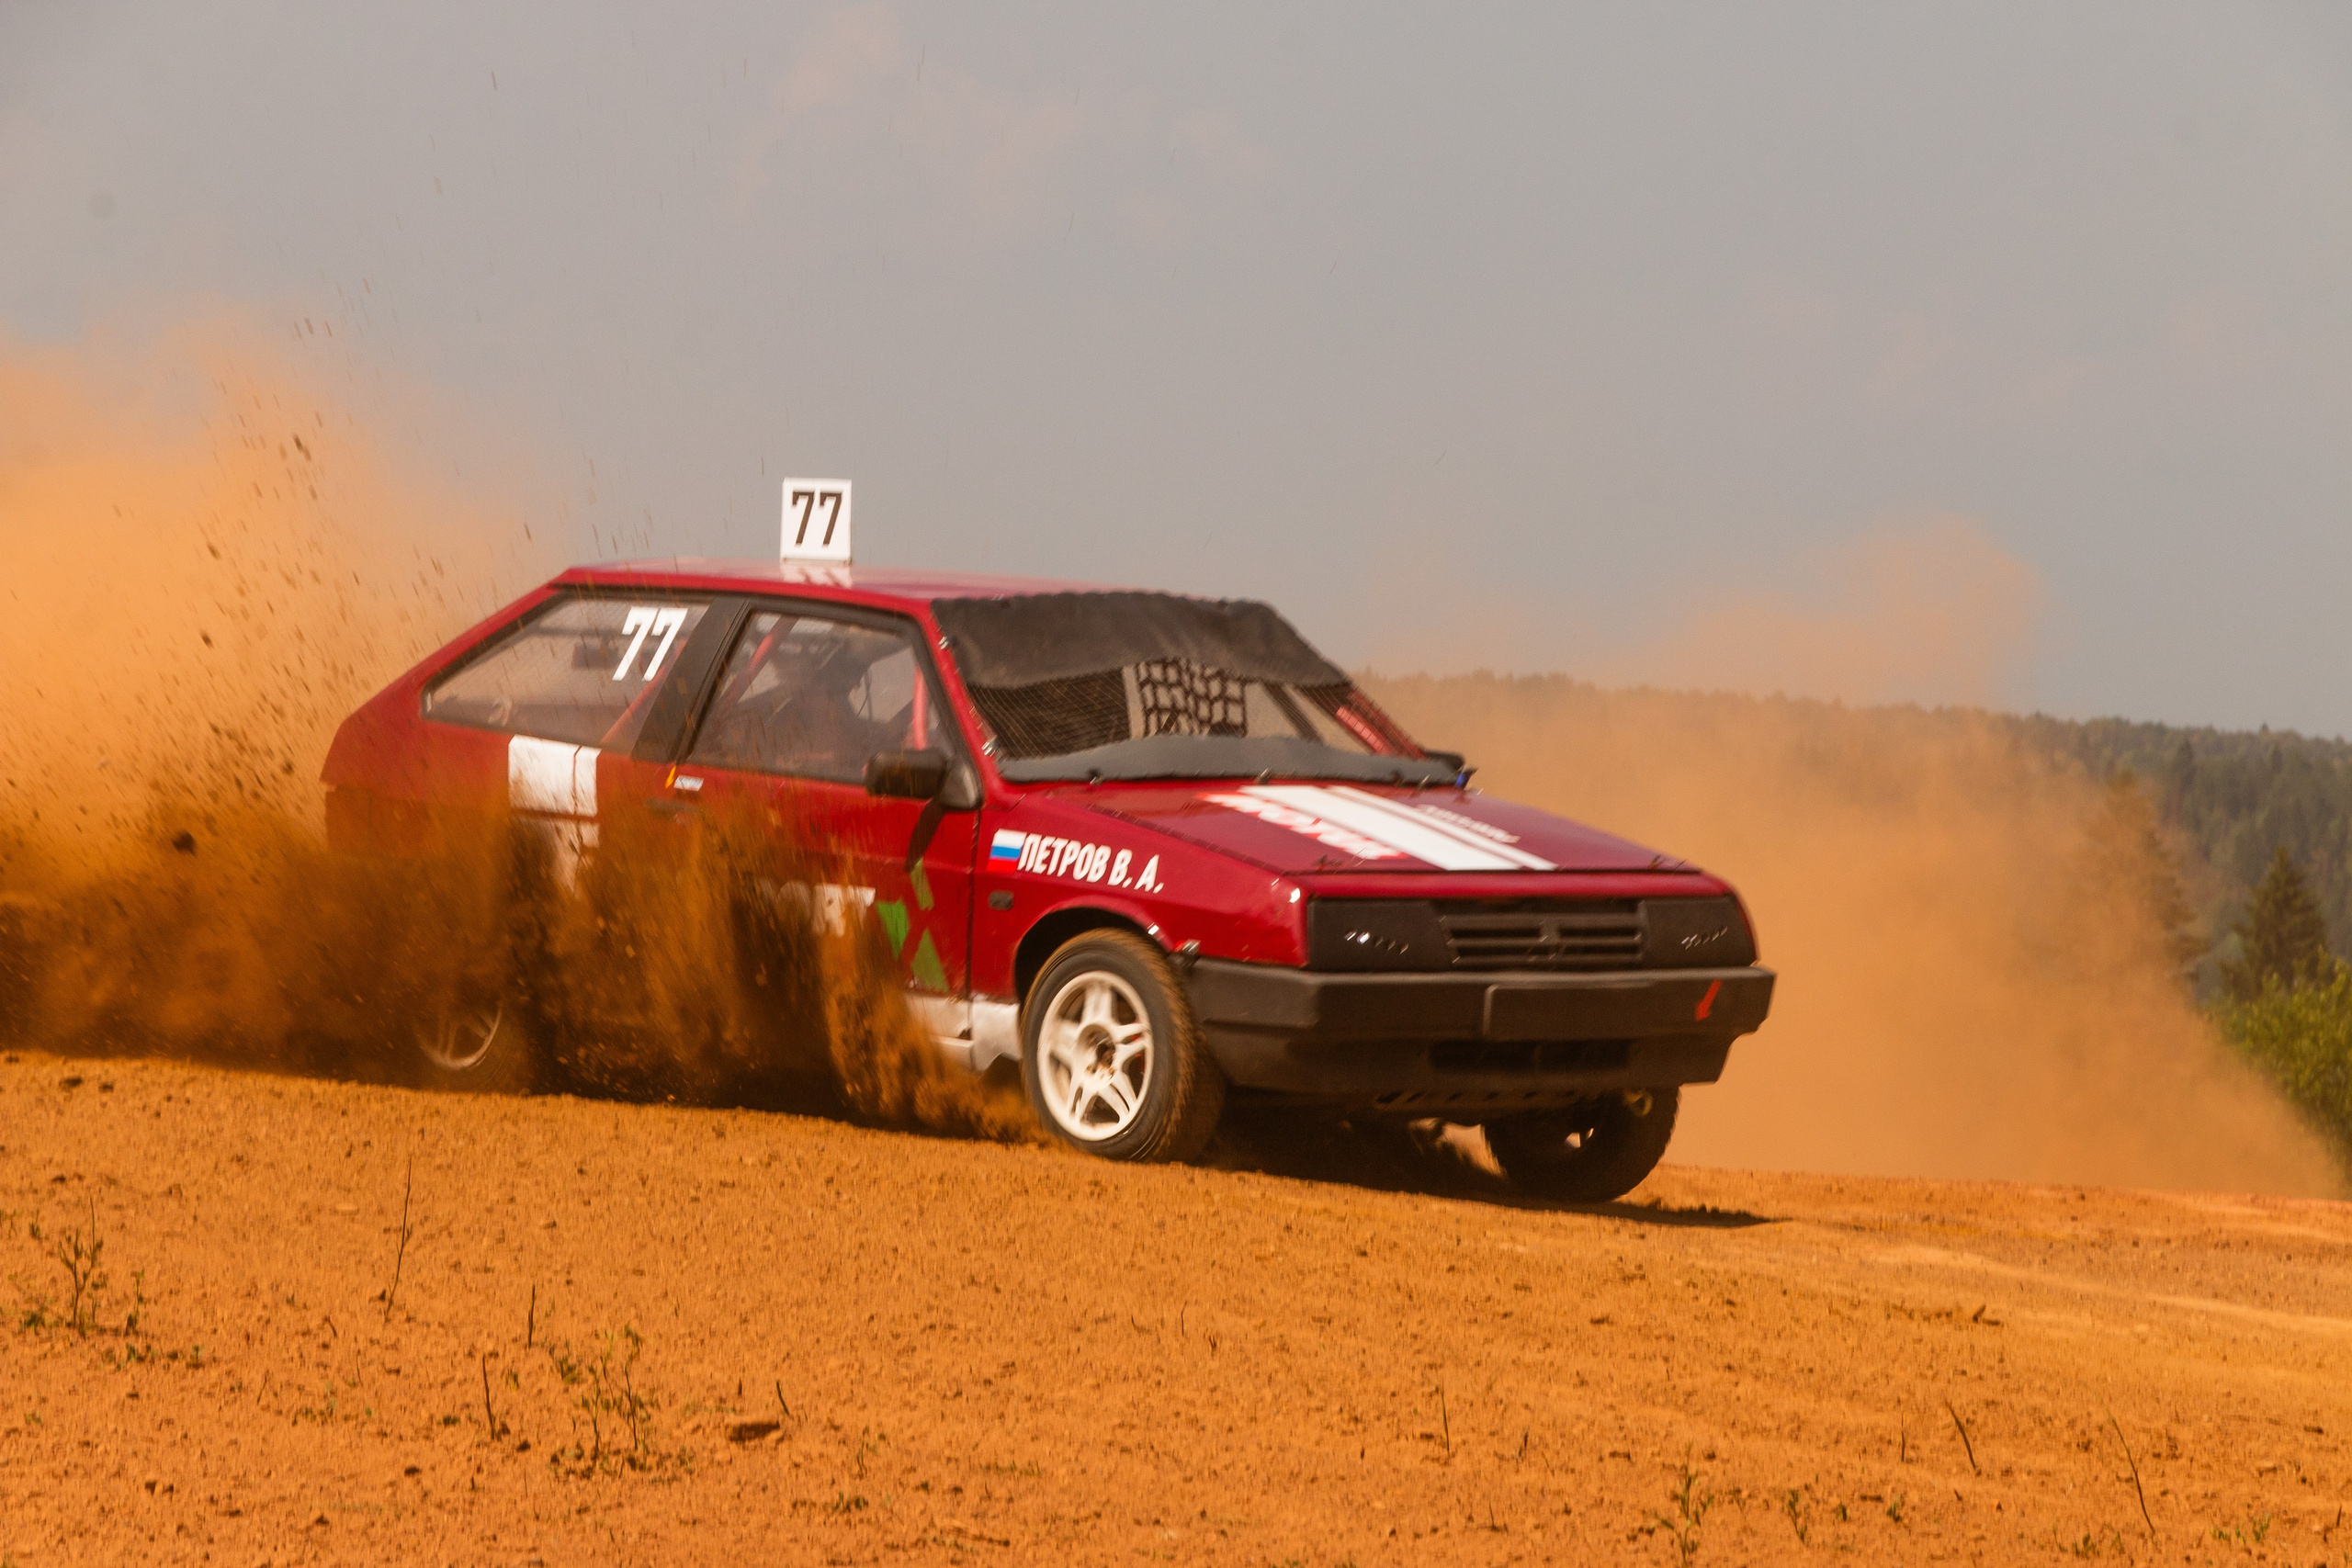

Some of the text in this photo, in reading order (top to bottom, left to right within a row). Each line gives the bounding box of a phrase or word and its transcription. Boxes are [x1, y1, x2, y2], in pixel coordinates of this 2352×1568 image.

[791, 491, 842, 547] 77
[612, 607, 688, 681] 77
[1017, 833, 1112, 883] ПЕТРОВ
